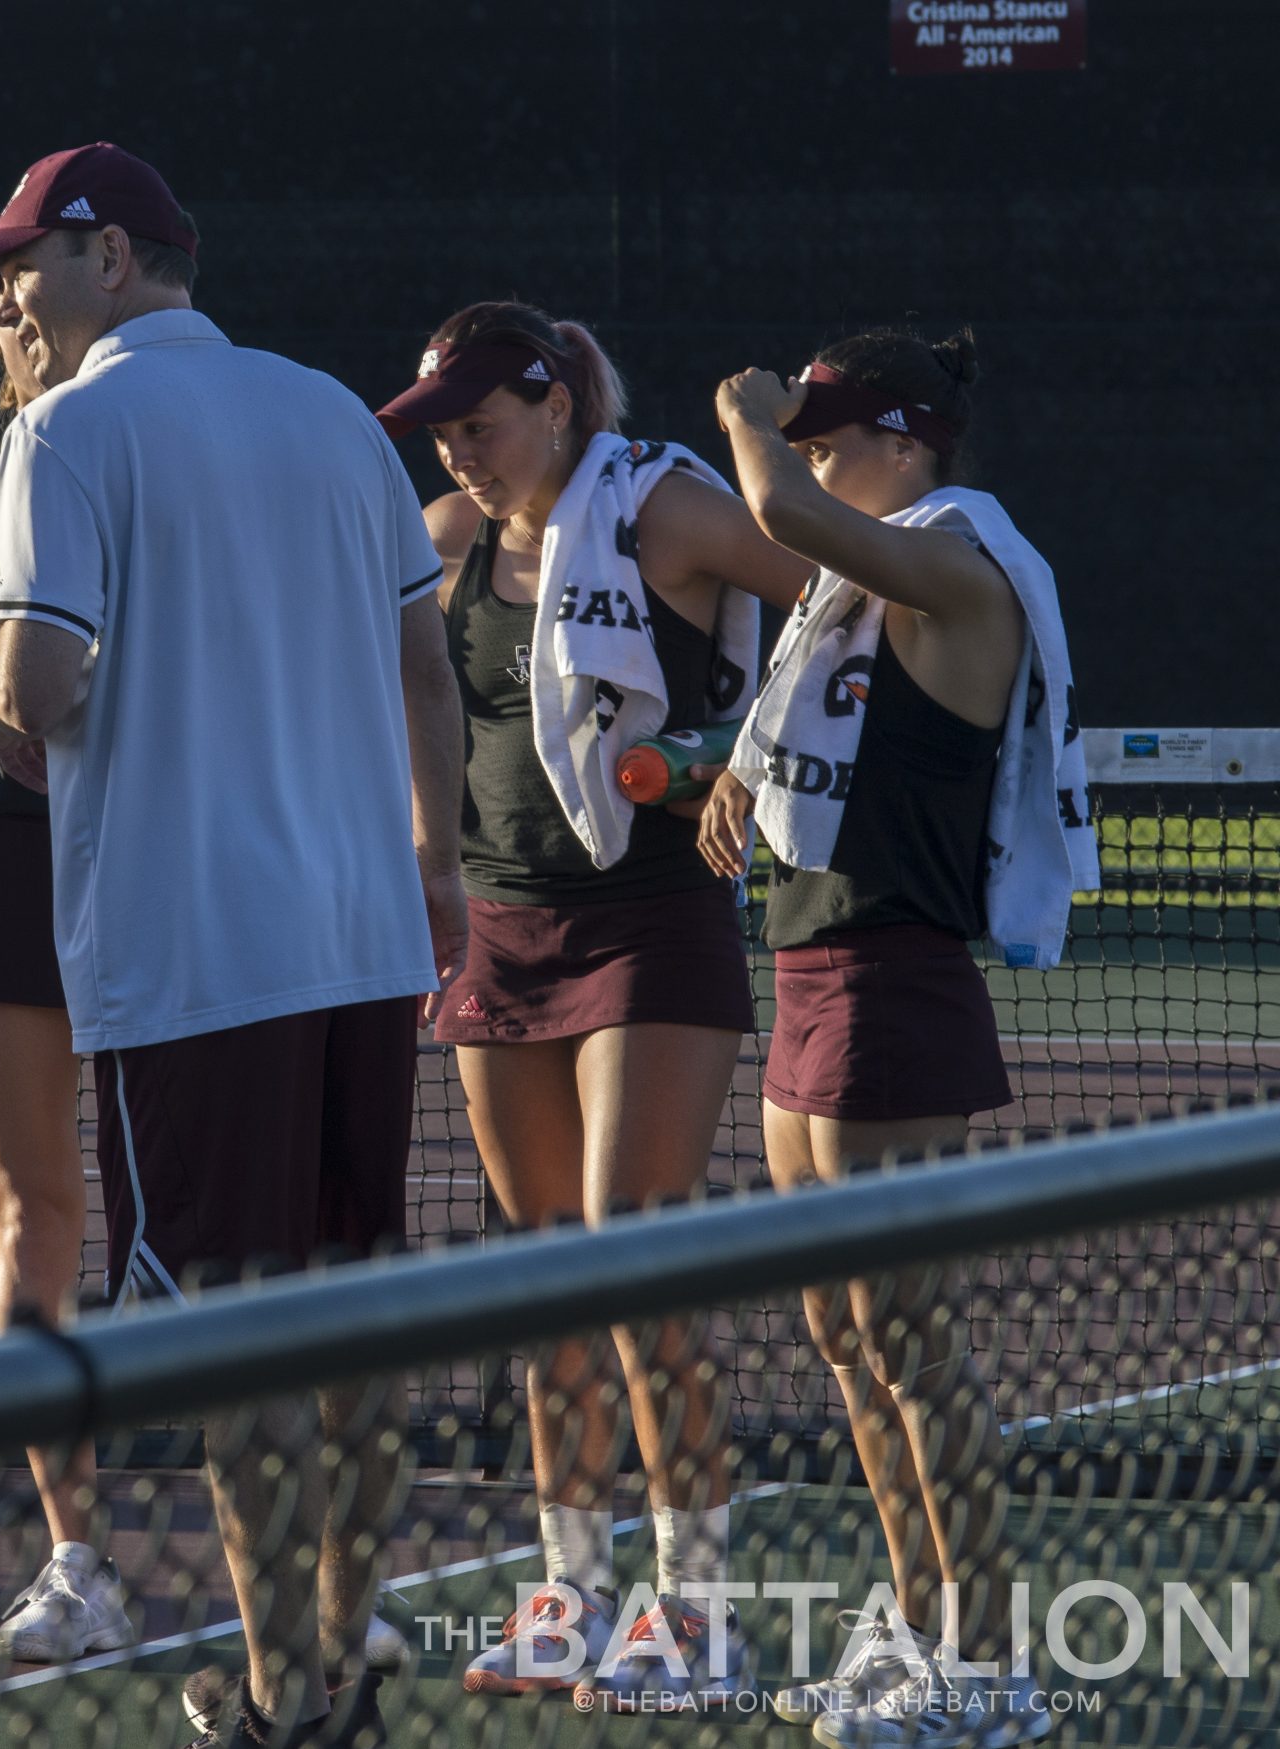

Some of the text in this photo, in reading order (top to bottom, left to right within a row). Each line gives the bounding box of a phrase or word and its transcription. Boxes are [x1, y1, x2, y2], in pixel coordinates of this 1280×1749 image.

[907, 0, 1068, 22] Cristina Stancu
[915, 25, 945, 46] All
[960, 23, 1060, 44] American
[963, 47, 1013, 67] 2014
[60, 210, 96, 221] adidas
[556, 583, 648, 633] GAT
[457, 1009, 486, 1019] adidas
